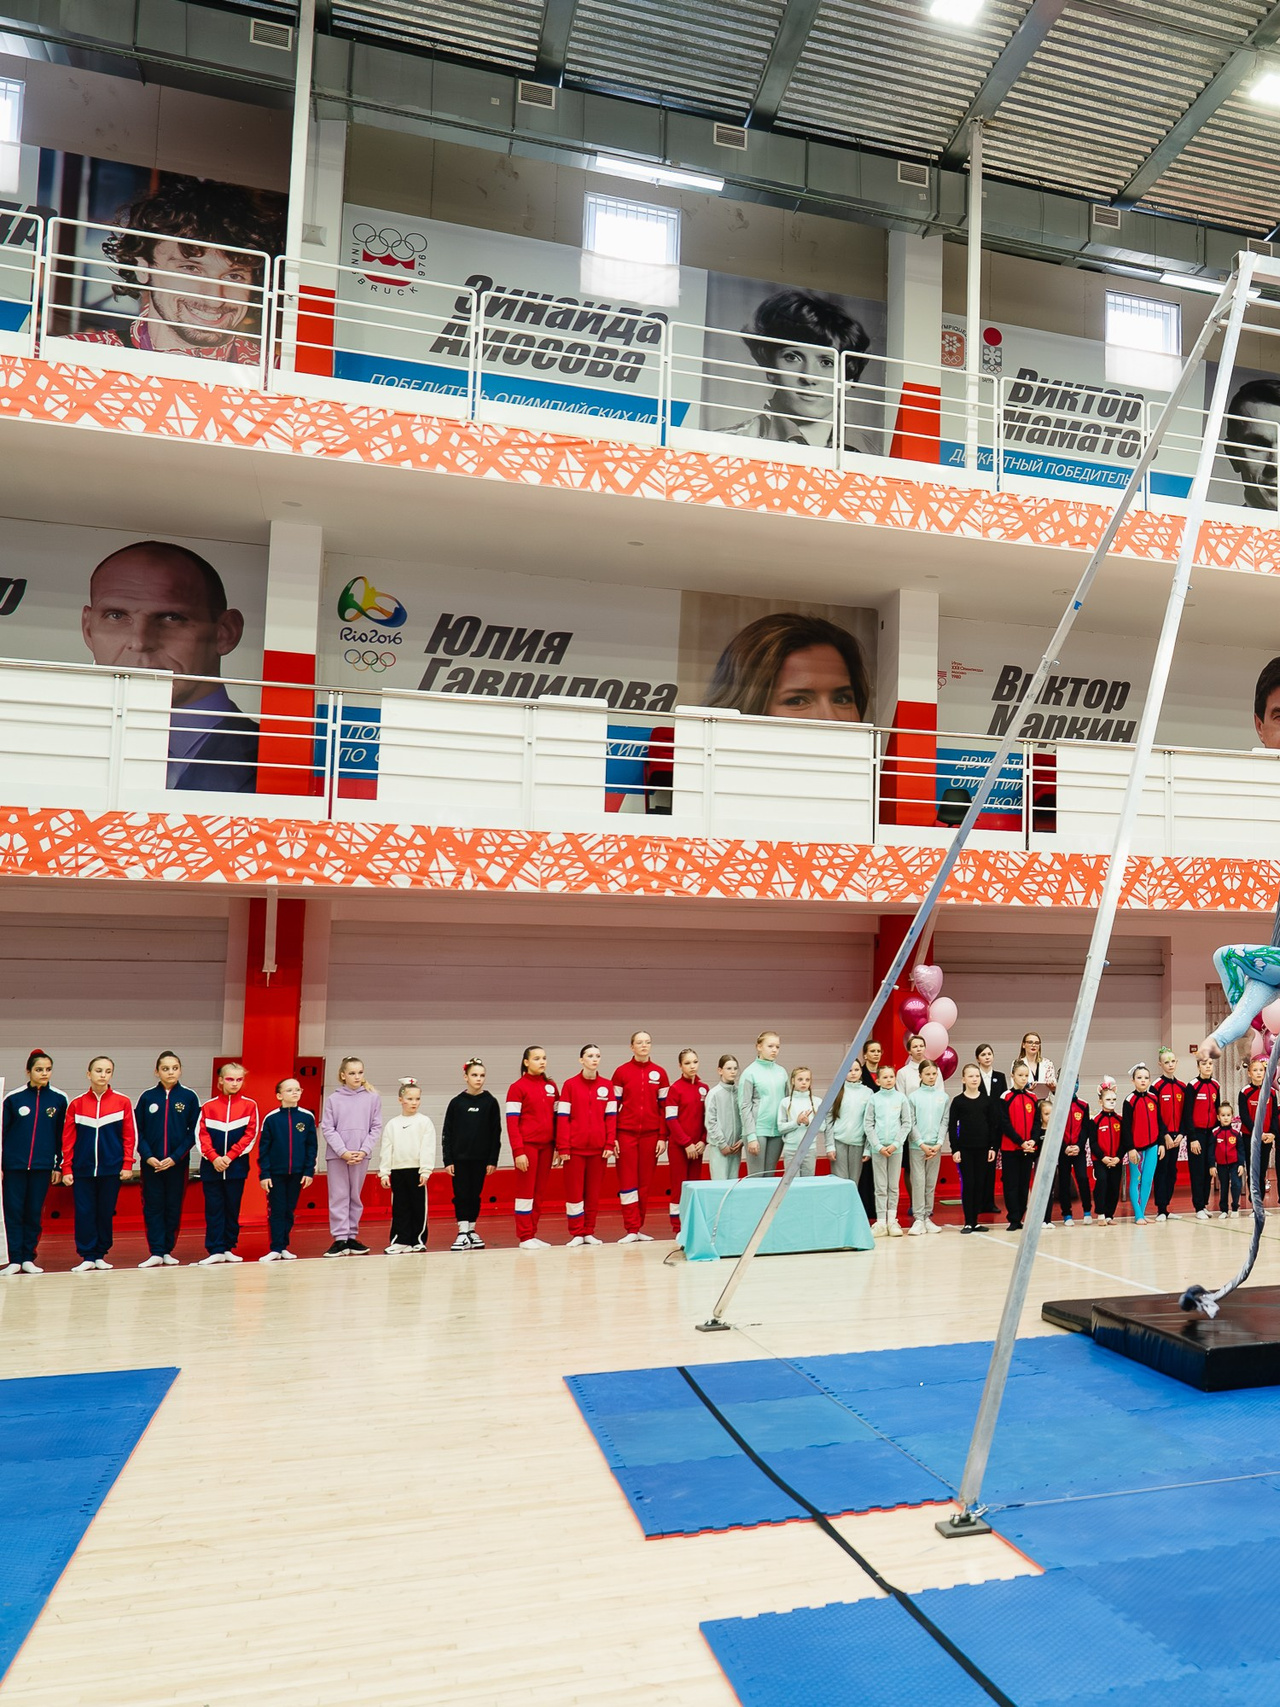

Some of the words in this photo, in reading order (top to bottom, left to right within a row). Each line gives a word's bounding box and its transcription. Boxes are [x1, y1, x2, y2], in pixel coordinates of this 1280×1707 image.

[351, 242, 418, 296] INNBRUCK
[453, 274, 669, 346] Зинаида
[1008, 367, 1145, 424] Виктор
[424, 612, 574, 665] Юлия
